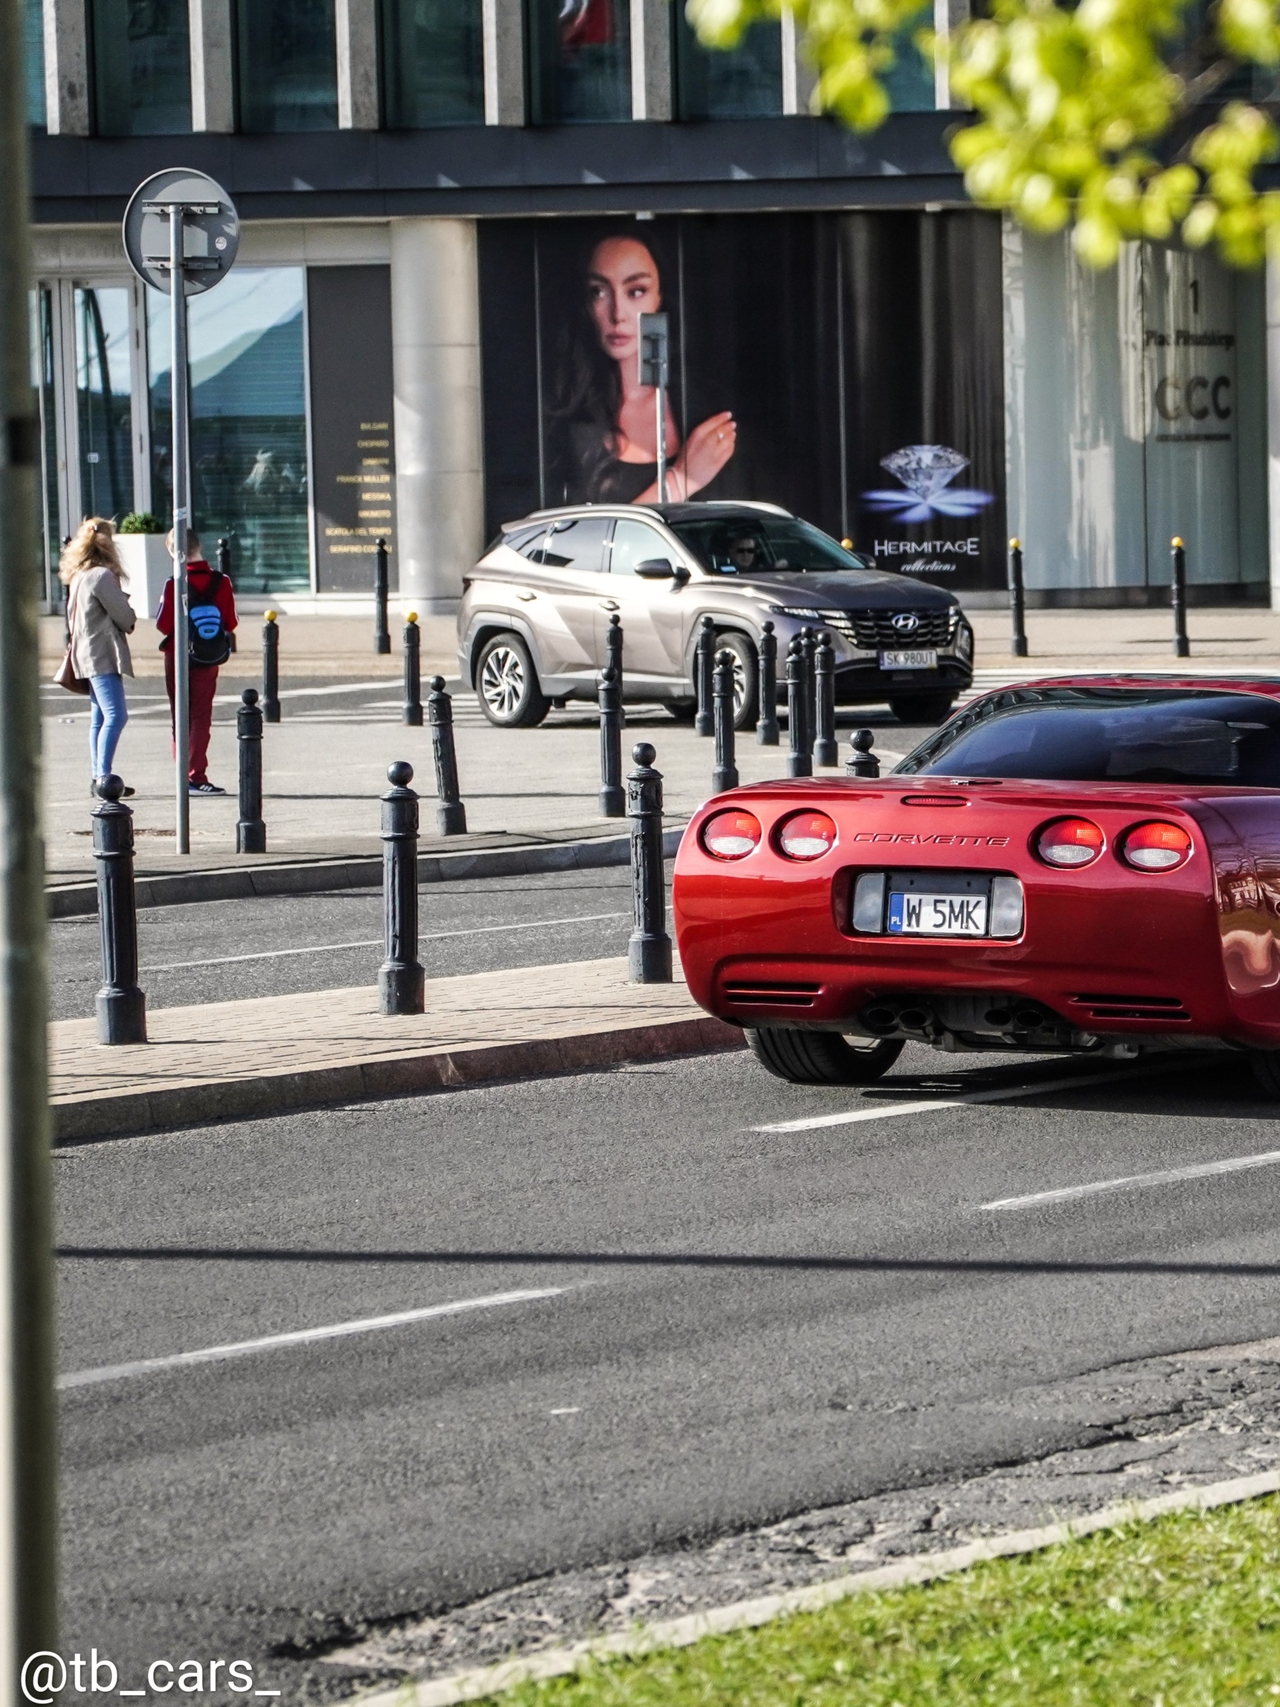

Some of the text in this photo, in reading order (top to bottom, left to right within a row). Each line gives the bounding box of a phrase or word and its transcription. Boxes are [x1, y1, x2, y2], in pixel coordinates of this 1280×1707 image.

[1190, 280, 1199, 314] 1
[1155, 375, 1232, 421] CCC
[874, 538, 979, 556] HERMITAGE
[901, 559, 956, 572] collections
[853, 832, 1011, 847] CORVETTE
[891, 898, 982, 930] PL W 5MK
